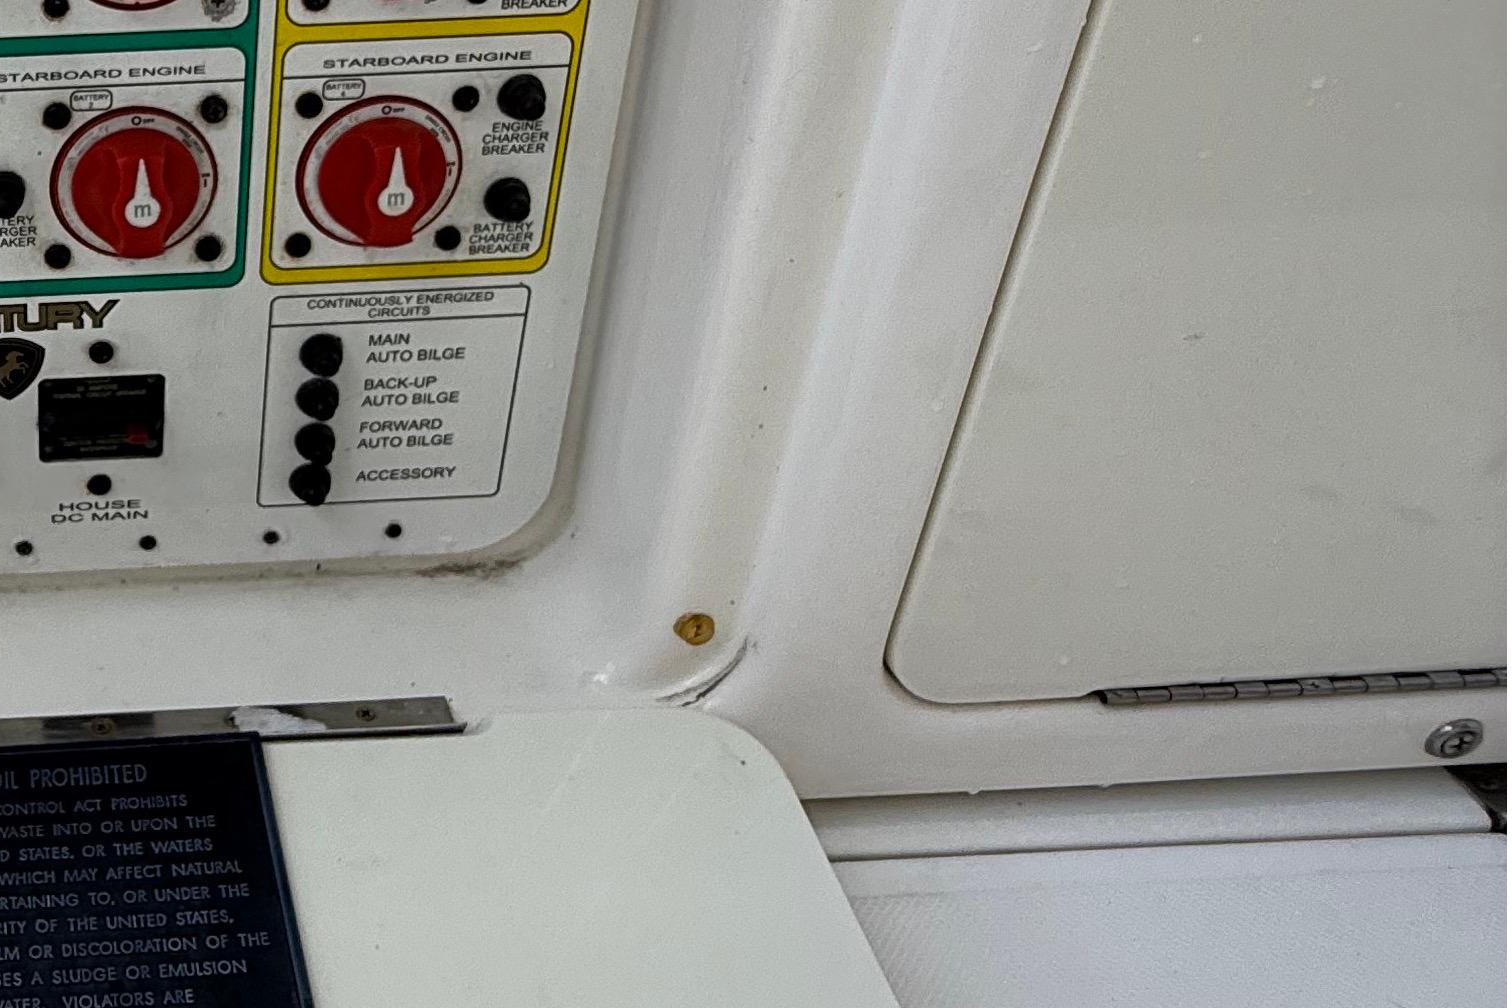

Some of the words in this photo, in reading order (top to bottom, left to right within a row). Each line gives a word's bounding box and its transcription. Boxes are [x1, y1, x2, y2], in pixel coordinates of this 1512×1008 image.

[323, 53, 449, 69] STARBOARD
[455, 50, 532, 63] ENGINE
[128, 64, 206, 77] ENGINE
[326, 82, 363, 91] BATTERY
[73, 94, 109, 102] BATTERY
[492, 120, 543, 133] ENGINE
[482, 131, 549, 144] CHARGER
[481, 143, 545, 156] BREAKER
[387, 192, 405, 206] m
[134, 203, 151, 217] m
[473, 221, 533, 234] BATTERY
[469, 231, 533, 244] CHARGER
[468, 243, 530, 255] BREAKER
[307, 295, 412, 310] CONTINUOUSLY
[416, 291, 494, 304] ENERGIZED
[368, 306, 431, 318] CIRCUITS
[368, 333, 410, 346] MAIN
[366, 350, 413, 363] AUTO
[417, 347, 465, 361] BILGE
[363, 376, 437, 391] BACK-UP
[361, 393, 407, 407] AUTO
[411, 391, 460, 405] BILGE
[359, 418, 443, 433] FORWARD
[357, 436, 402, 450] AUTO
[406, 433, 454, 447] BILGE
[355, 466, 456, 482] ACCESSORY
[59, 499, 142, 512] HOUSE
[50, 513, 85, 524] DC
[91, 509, 149, 522] MAIN
[29, 764, 147, 789] PROHIBITED
[74, 799, 102, 812] ACT
[111, 794, 188, 810] PROHIBITS
[52, 822, 92, 837] INTO
[100, 820, 124, 834] OR
[131, 817, 178, 832] UPON
[186, 815, 216, 829] THE
[28, 944, 54, 959] OR
[62, 936, 197, 957] DISCOLORATION
[205, 934, 230, 949] OF
[238, 931, 271, 946] THE
[31, 971, 44, 985] A
[52, 967, 117, 984] SLUDGE
[125, 964, 151, 979] OR
[159, 959, 247, 979] EMULSION
